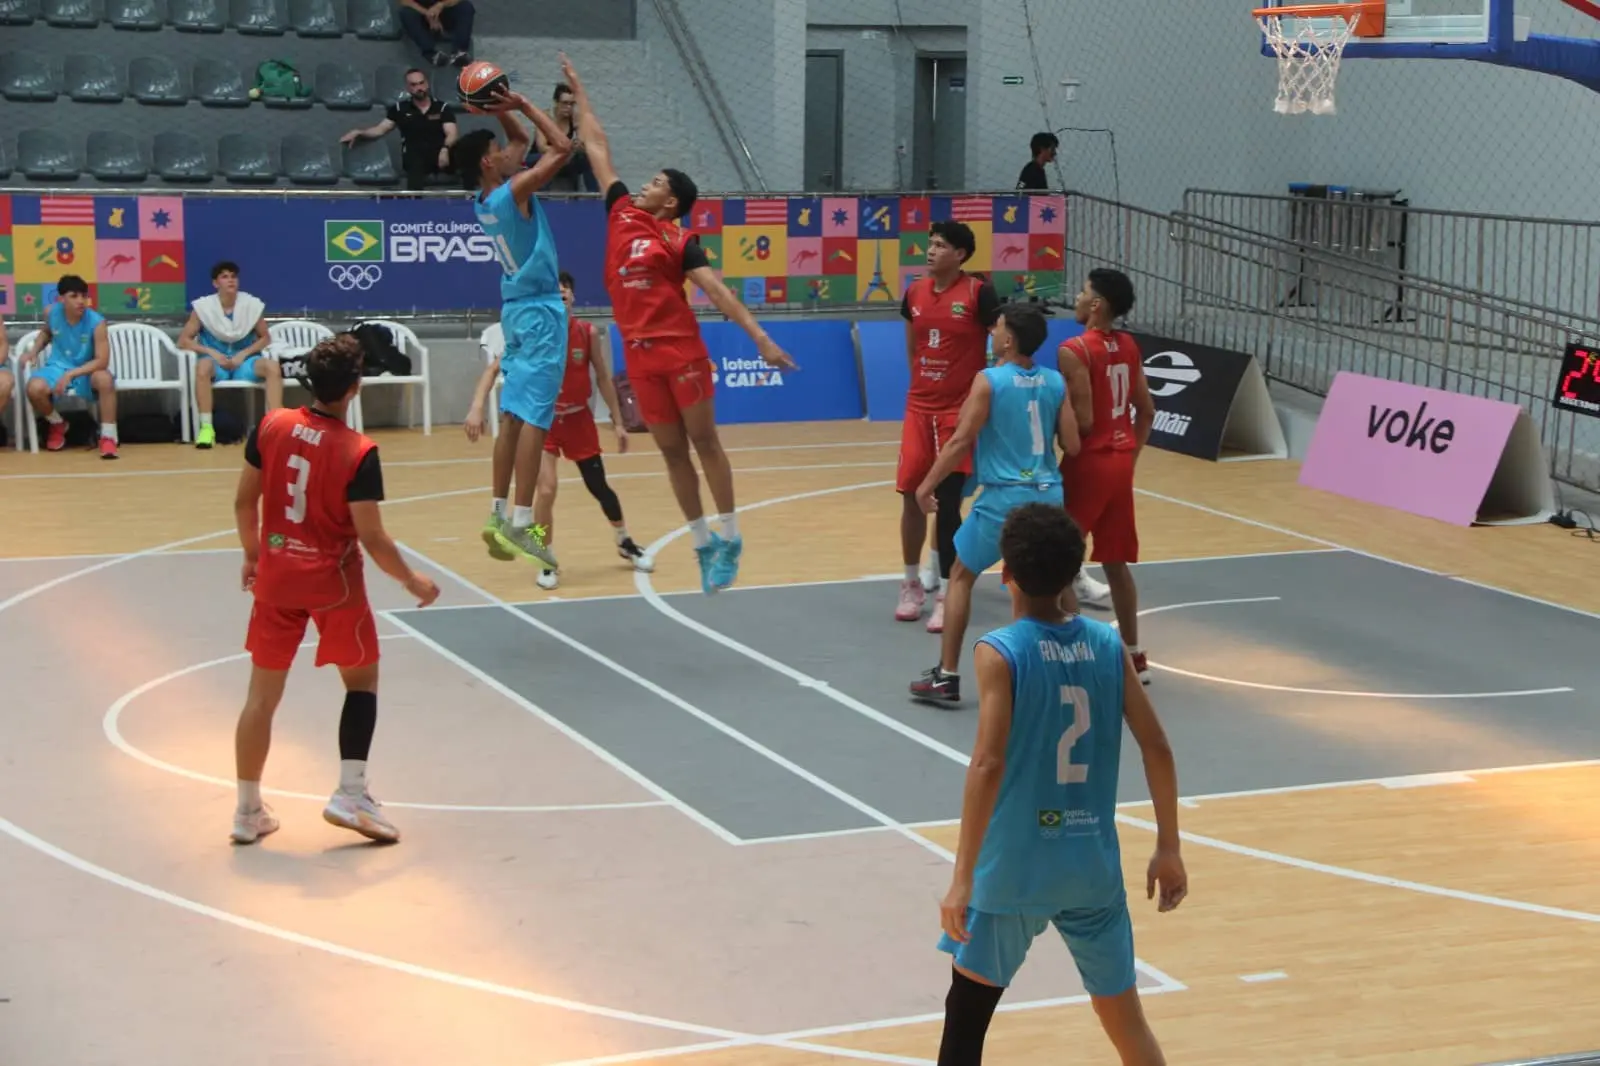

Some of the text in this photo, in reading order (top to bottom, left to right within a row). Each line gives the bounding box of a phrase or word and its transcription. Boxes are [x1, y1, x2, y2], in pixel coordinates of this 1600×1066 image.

[390, 221, 434, 234] COMITÉ
[390, 235, 500, 263] BRAS
[722, 355, 779, 371] loteri
[725, 371, 784, 387] CAIXA
[1106, 363, 1130, 419] 10
[1026, 400, 1045, 456] 1
[1367, 402, 1455, 454] voke
[284, 454, 310, 524] 3
[1056, 684, 1091, 785] 2
